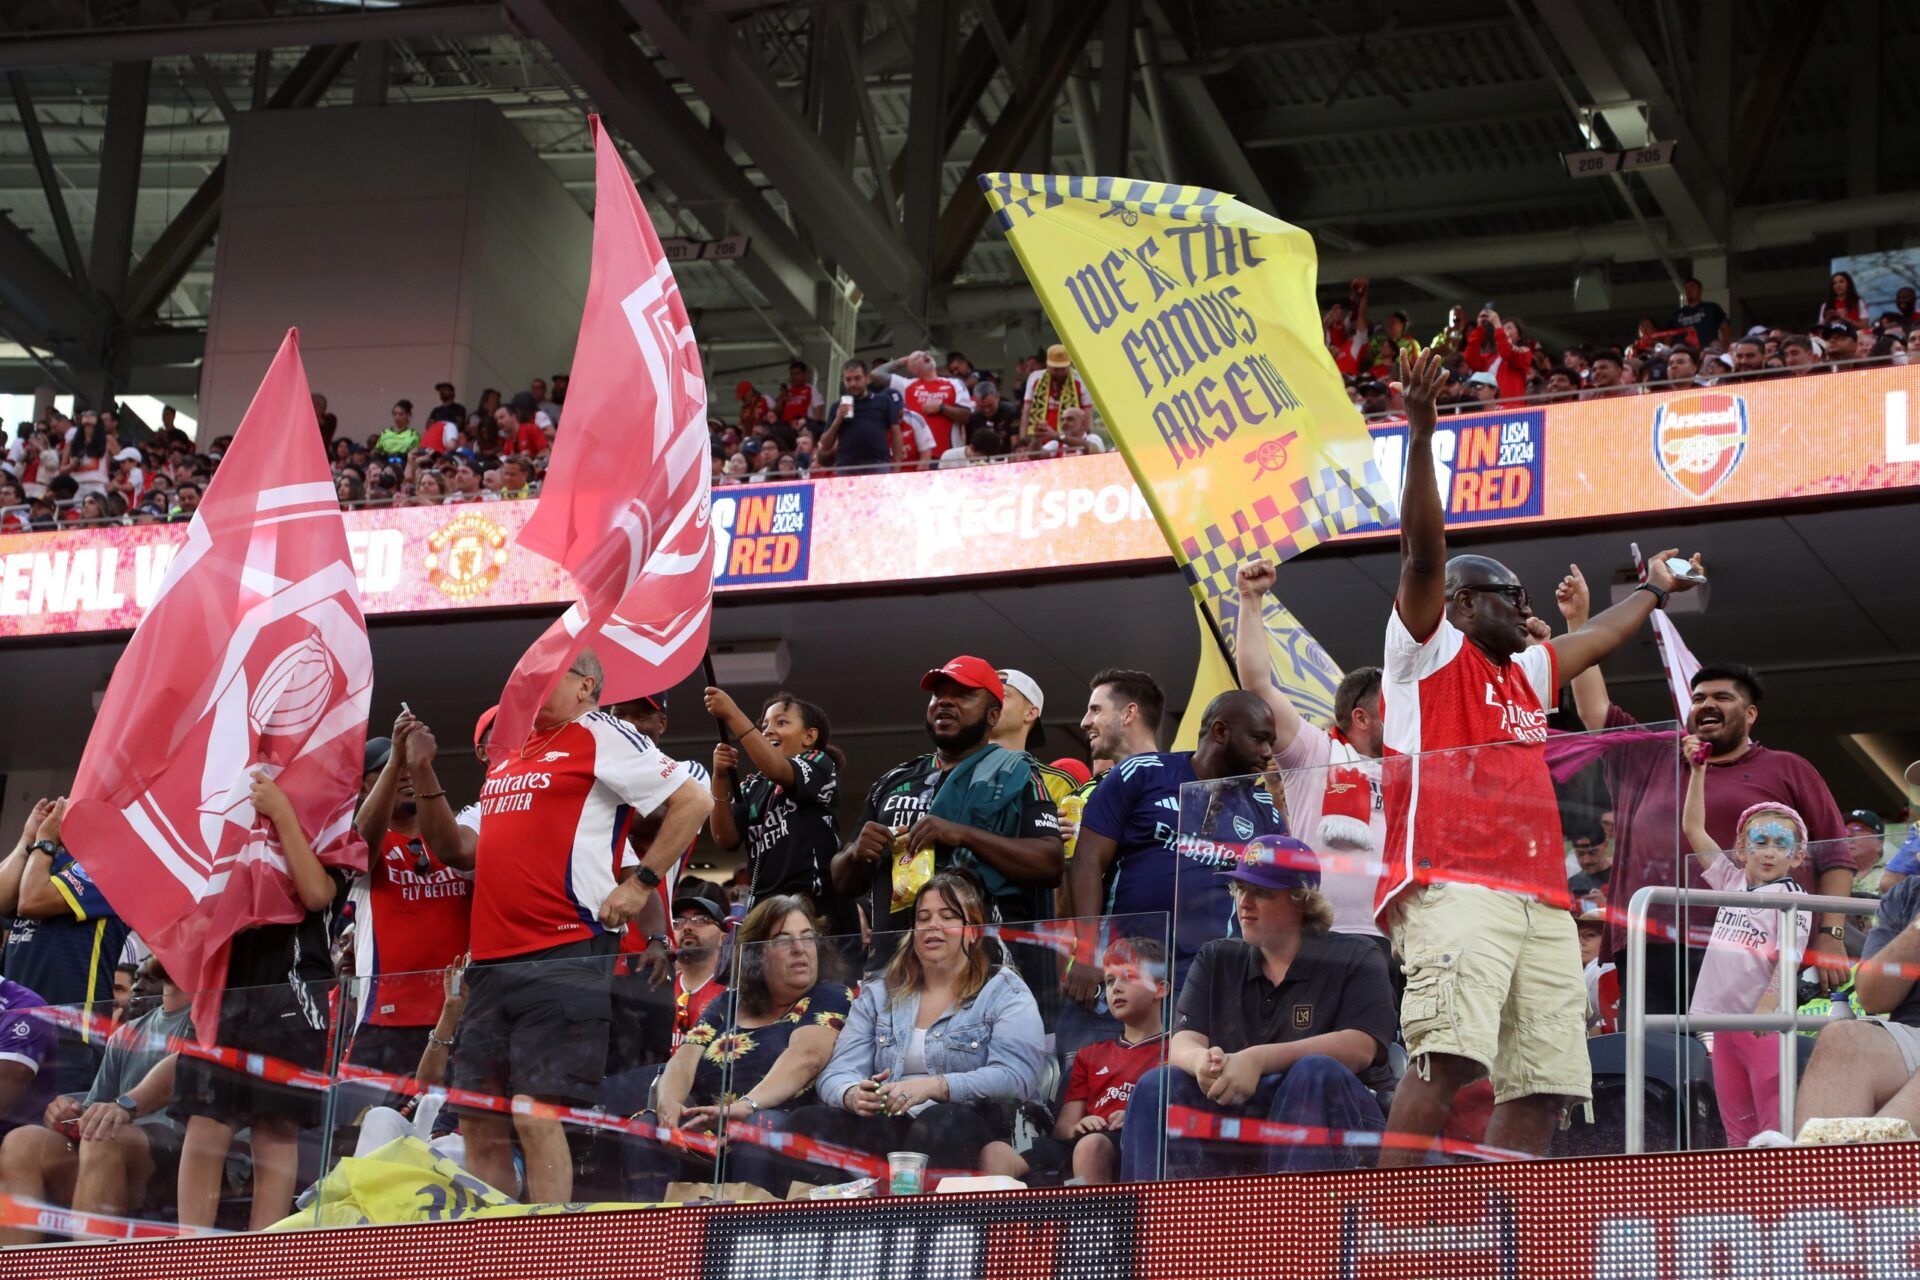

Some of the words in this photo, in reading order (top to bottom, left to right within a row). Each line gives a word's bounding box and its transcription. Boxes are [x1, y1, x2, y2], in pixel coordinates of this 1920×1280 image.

[1579, 157, 1604, 172] 206
[1635, 149, 1661, 163] 205
[665, 246, 688, 258] 207
[714, 242, 737, 255] 206
[1457, 424, 1501, 470] IN
[1502, 422, 1529, 444] USA
[1498, 442, 1533, 466] 2024
[1451, 467, 1533, 513] RED
[736, 495, 777, 535] IN
[776, 493, 800, 513] USA
[771, 512, 803, 534] 2024
[728, 534, 800, 576] RED
[0, 547, 124, 615] ENAL
[495, 793, 533, 813] BETTER
[402, 885, 420, 901] FLY
[424, 881, 466, 898] BETTER
